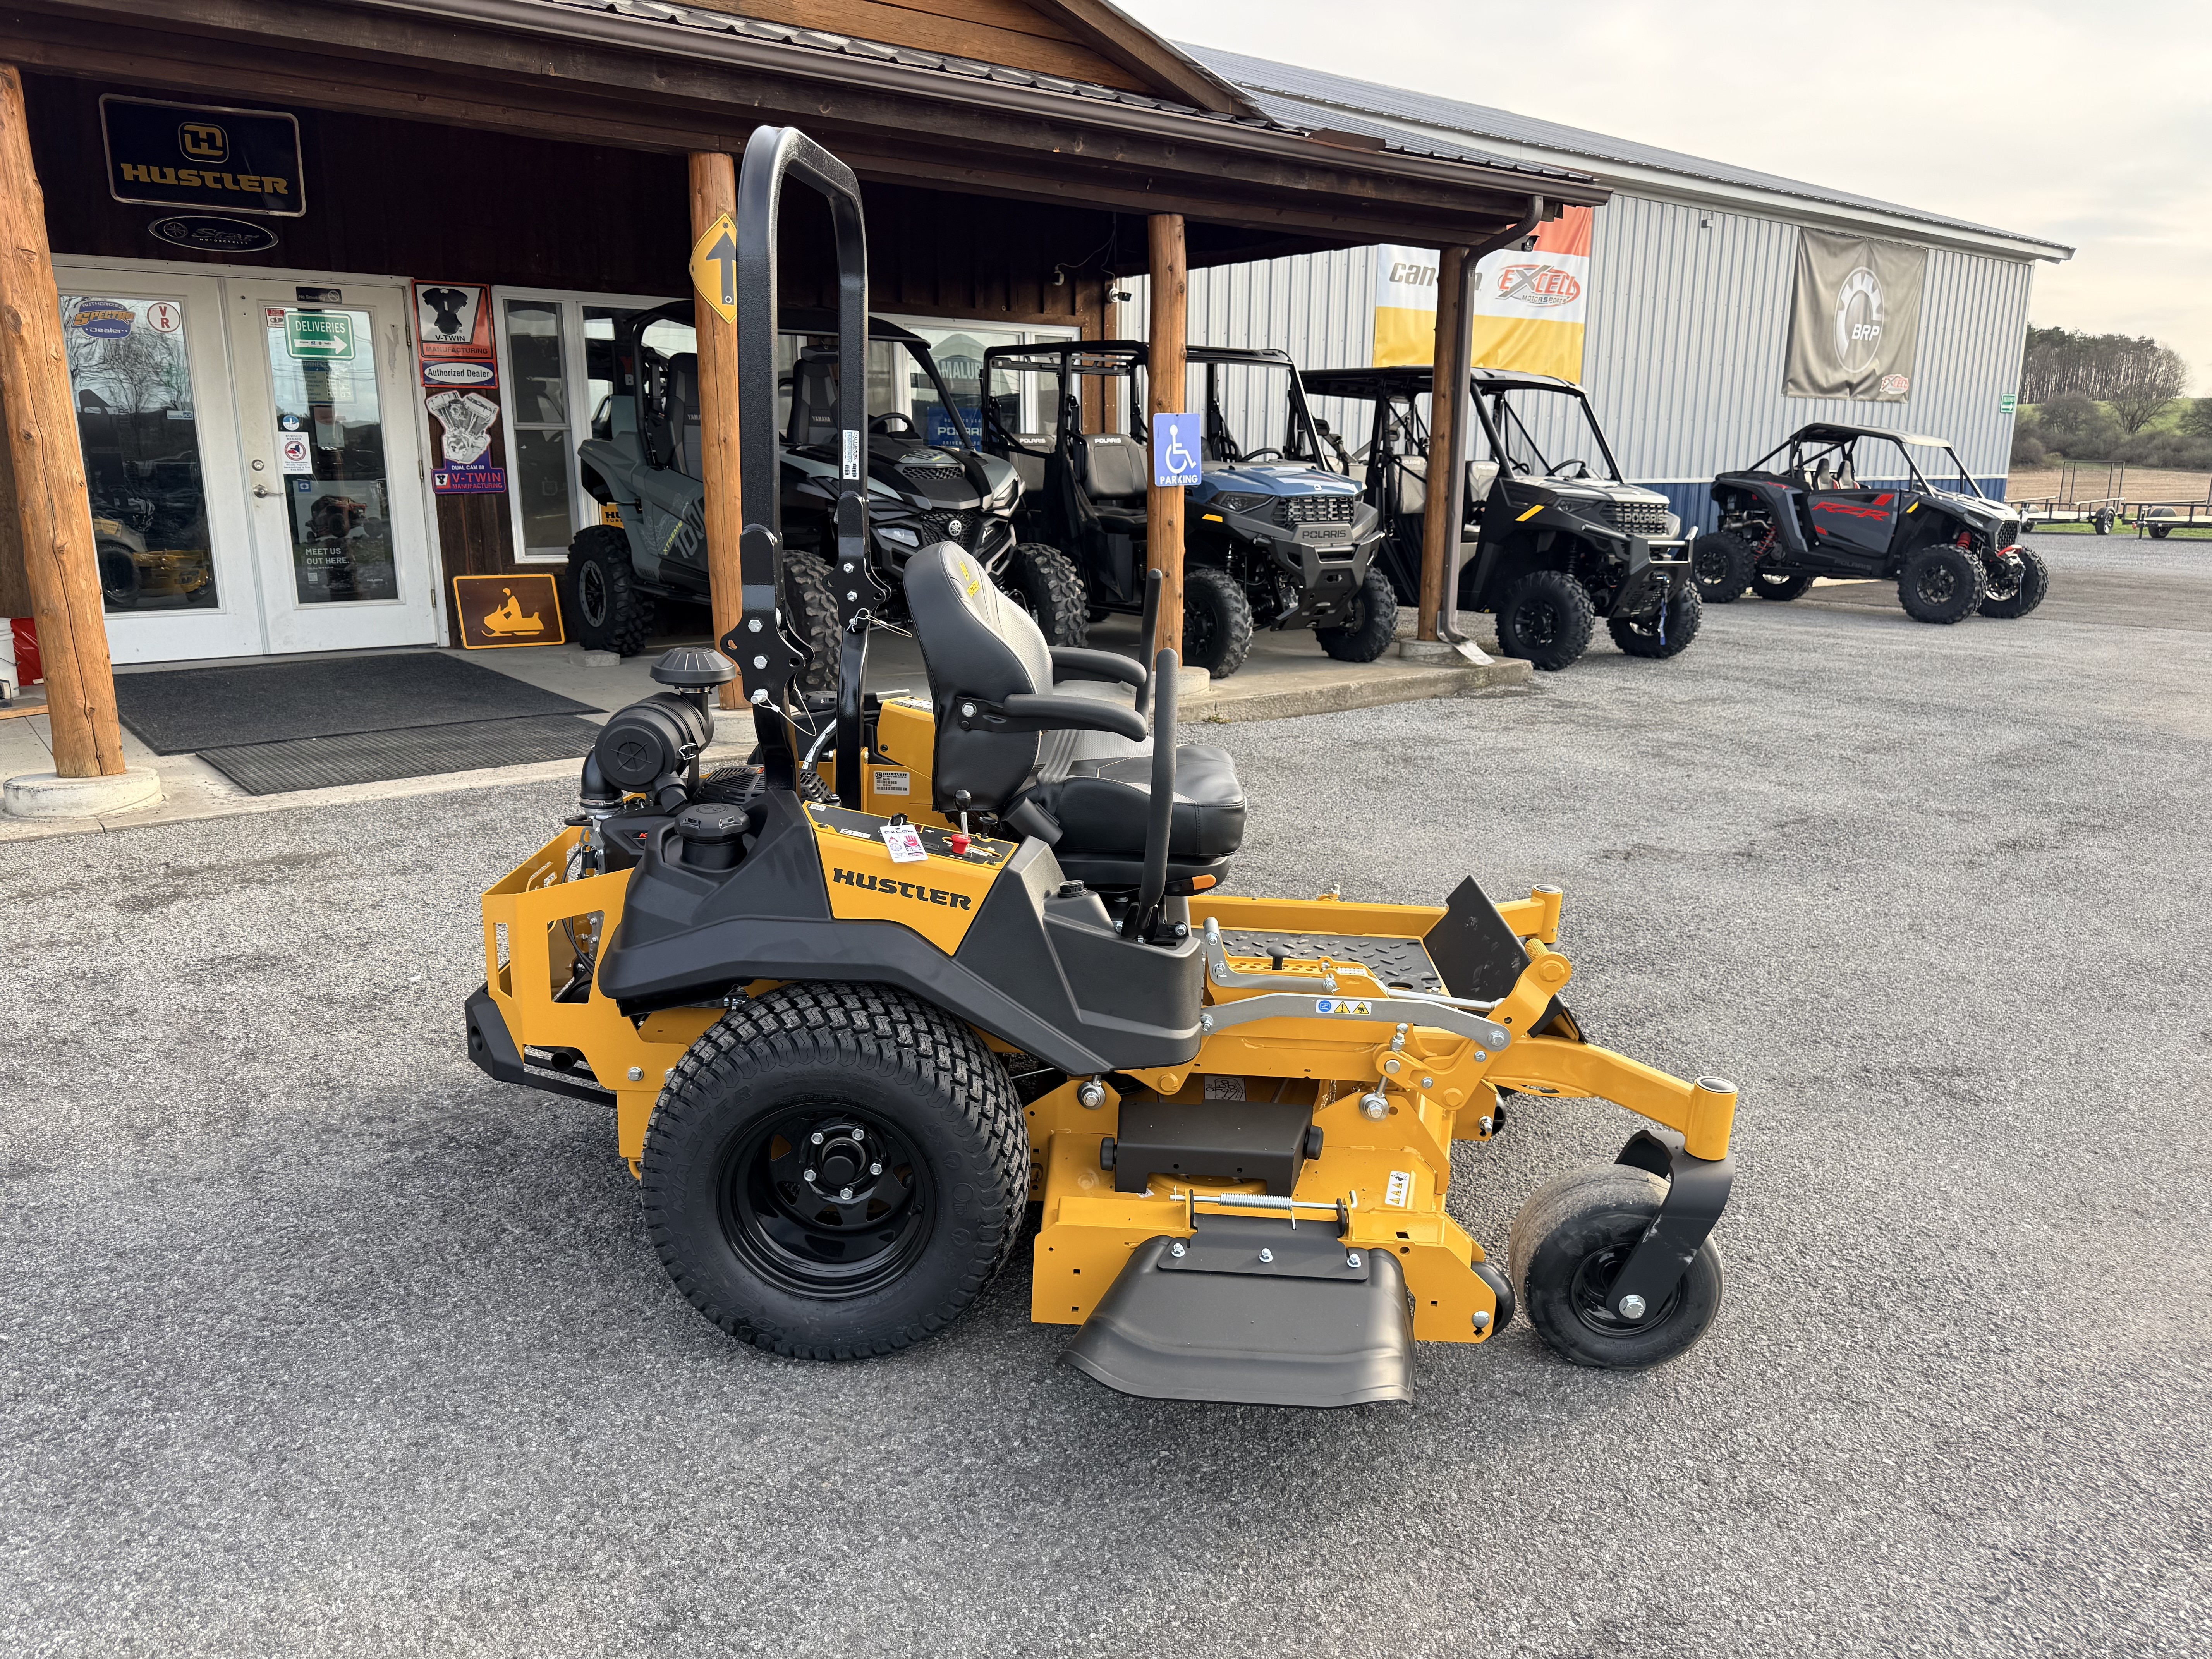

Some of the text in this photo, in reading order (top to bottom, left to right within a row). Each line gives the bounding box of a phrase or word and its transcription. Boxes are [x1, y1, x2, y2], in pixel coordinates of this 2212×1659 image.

[120, 163, 288, 194] HUSTLER
[158, 306, 167, 317] V
[73, 311, 135, 326] SPECTRO
[160, 318, 171, 328] R
[295, 321, 345, 333] DELIVERIES
[1851, 323, 1880, 341] BRP
[426, 346, 488, 354] MANUFACTURING
[428, 368, 490, 378] Authorized Dealer
[938, 427, 982, 436] POARI
[452, 472, 501, 483] V-TWIN
[1159, 475, 1198, 485] PARKING
[1812, 501, 1890, 521] RZR
[1625, 513, 1667, 524] POLARIS
[1302, 530, 1346, 539] POLARIS
[1834, 559, 1872, 570] POLARIS
[833, 868, 971, 911] HUSTLER
